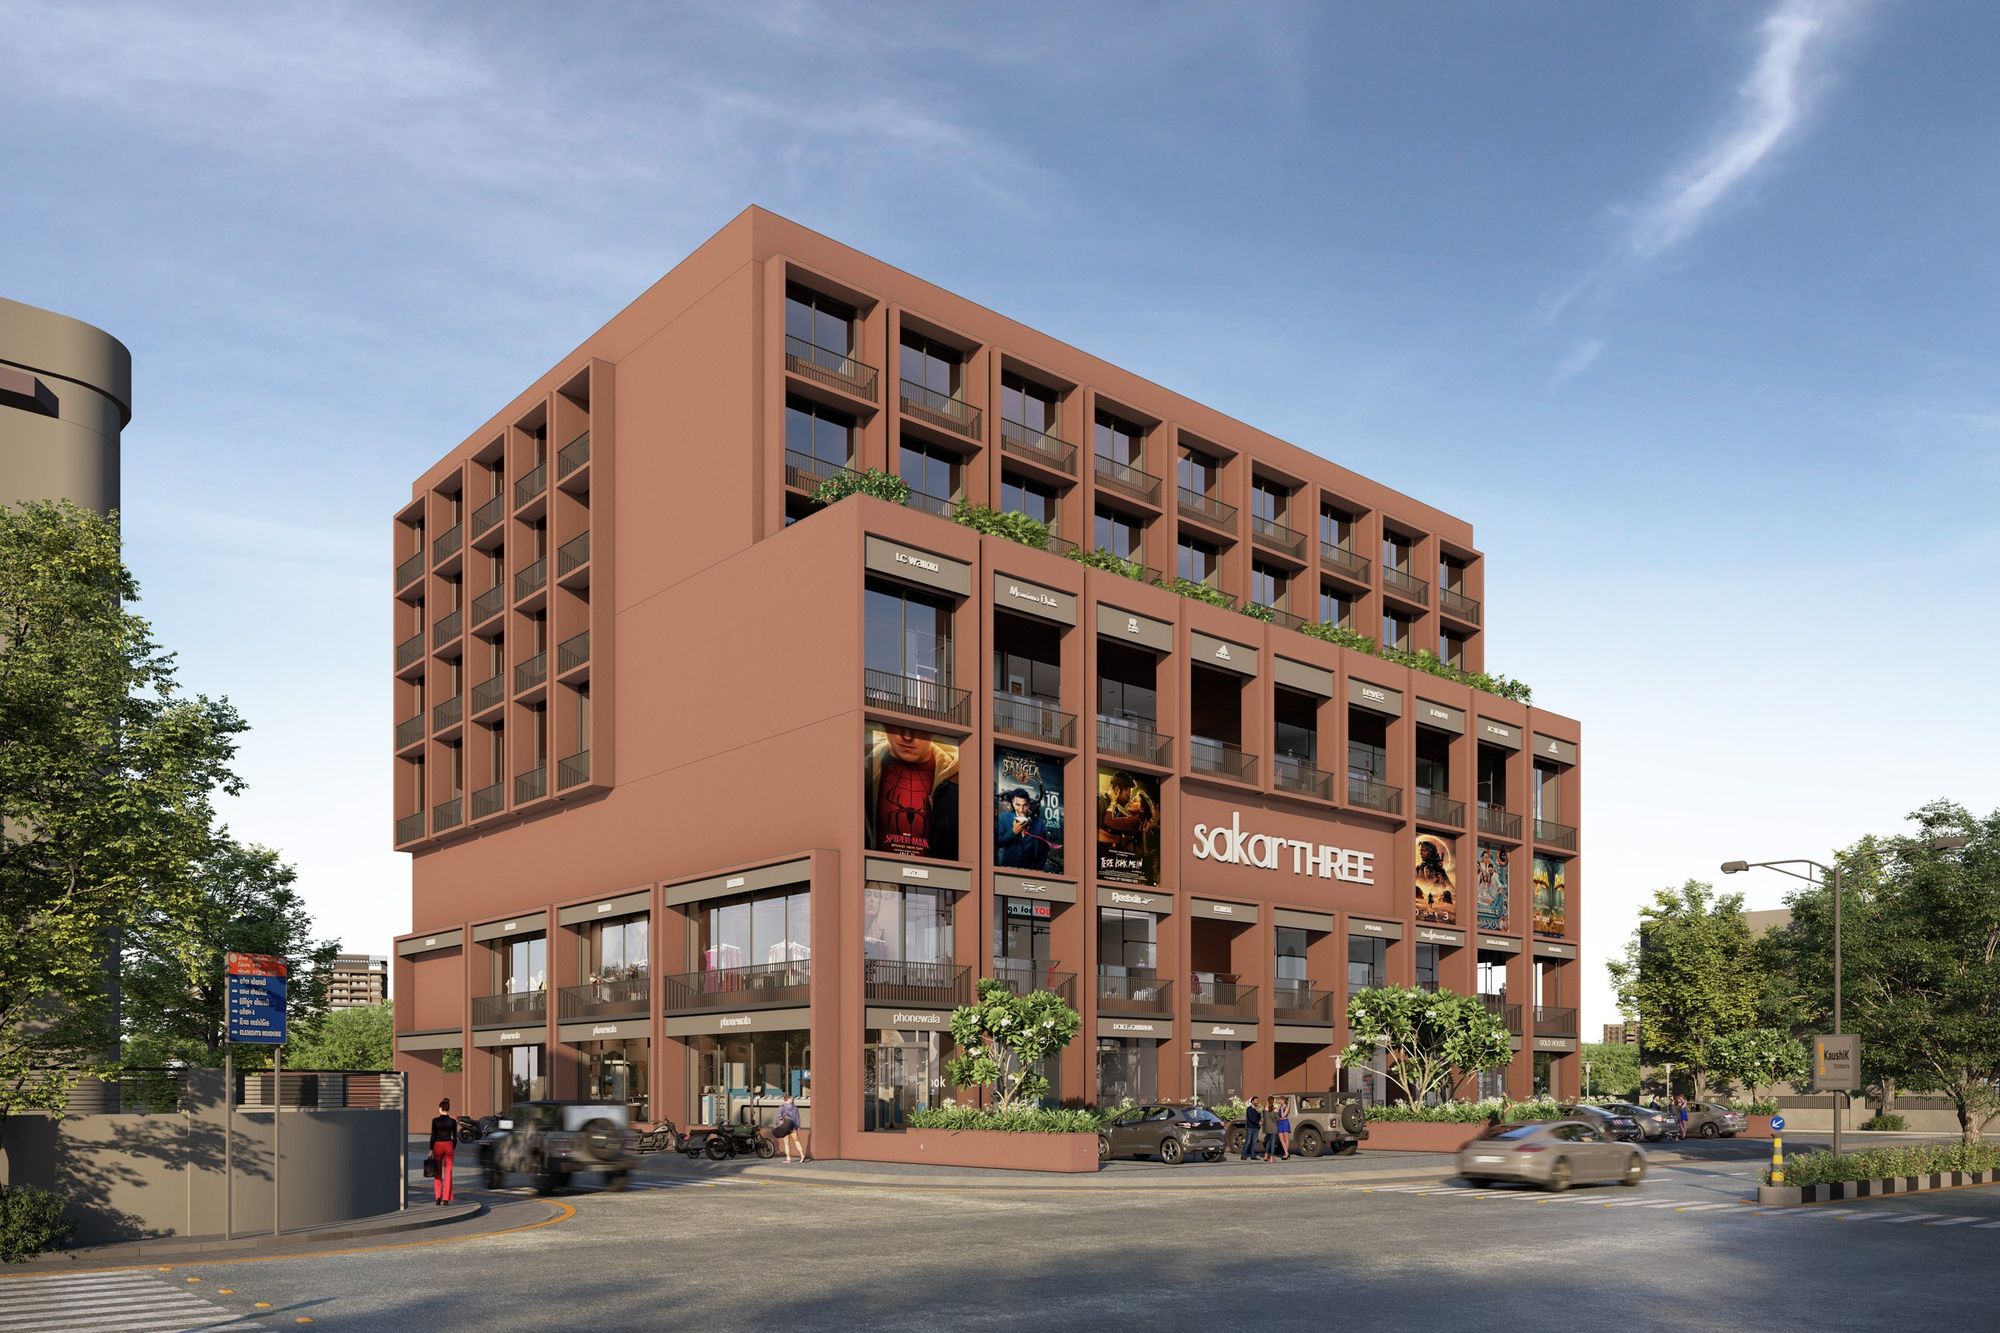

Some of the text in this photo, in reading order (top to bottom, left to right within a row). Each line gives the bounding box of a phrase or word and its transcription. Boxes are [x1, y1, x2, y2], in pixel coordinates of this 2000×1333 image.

[1046, 794, 1059, 808] 10
[1045, 807, 1060, 821] 04
[883, 833, 929, 848] SPIDER-MAN
[1442, 911, 1449, 920] 3
[720, 1016, 752, 1029] phonewala
[893, 1012, 941, 1024] phonewala
[1539, 1039, 1567, 1048] GOLD HOUSE
